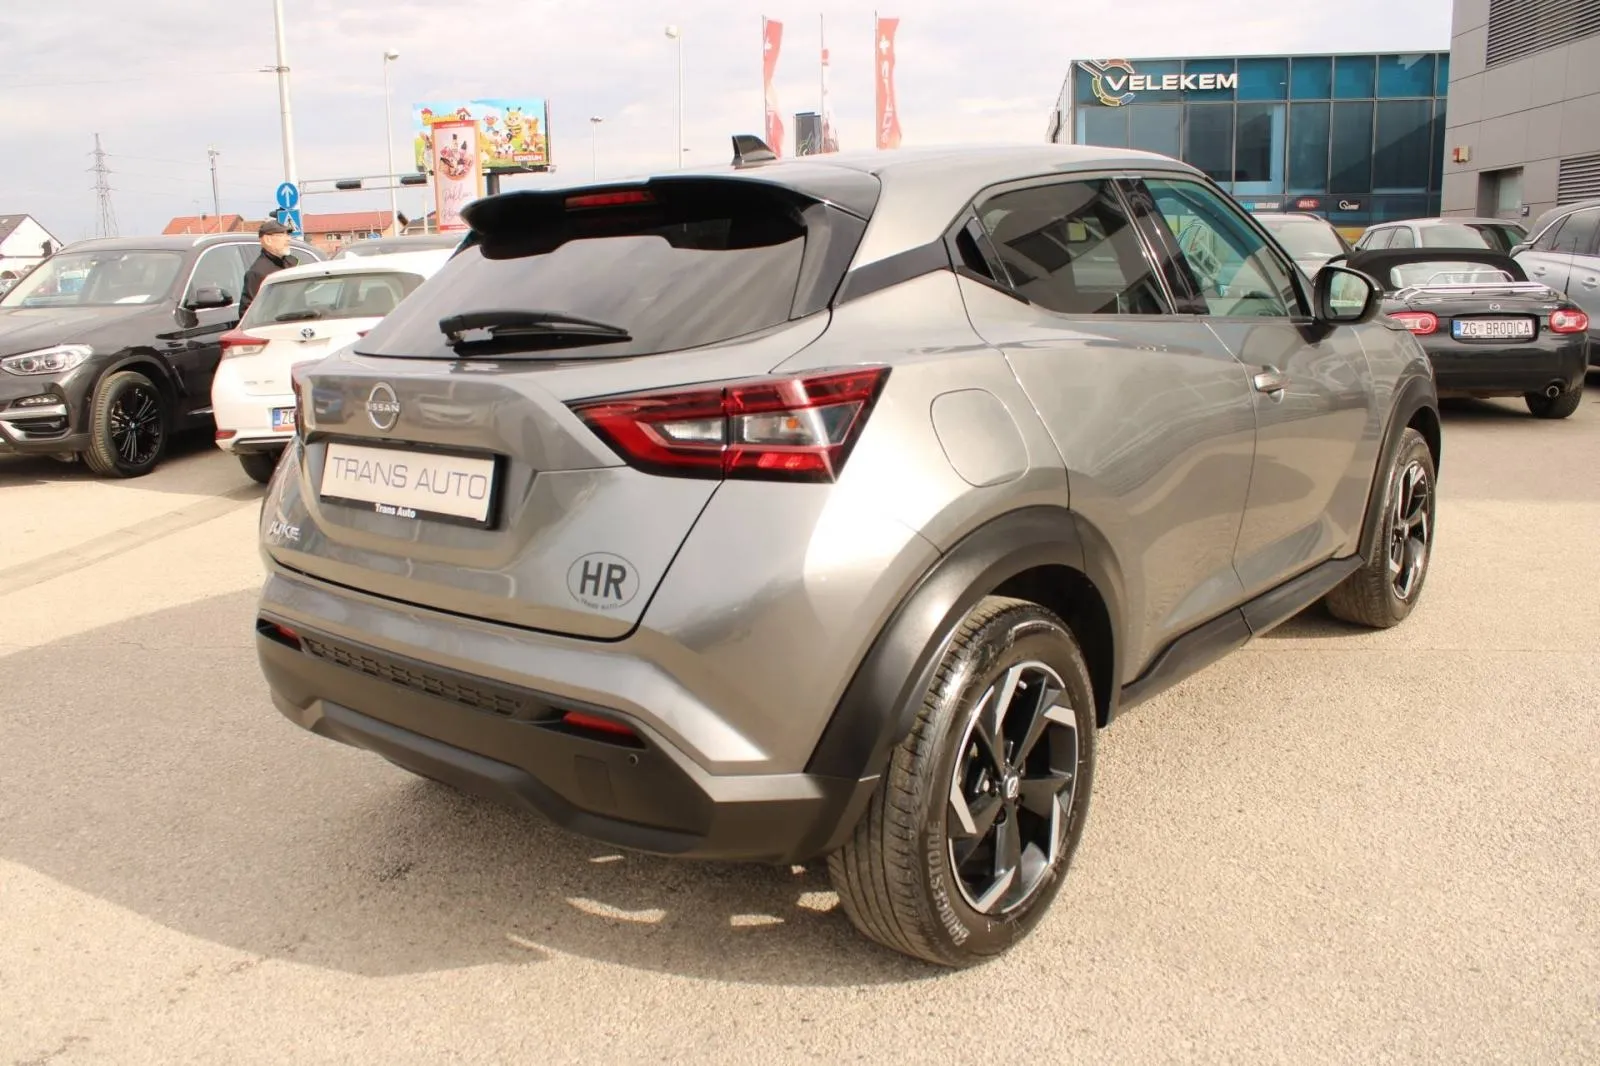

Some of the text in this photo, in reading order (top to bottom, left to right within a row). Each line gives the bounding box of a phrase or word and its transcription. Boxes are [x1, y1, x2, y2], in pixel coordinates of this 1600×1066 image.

[1105, 73, 1238, 91] VELEKEM
[1462, 322, 1531, 335] ZG BRODICA
[366, 401, 400, 412] NISSAN
[332, 456, 488, 500] TRANS AUTO
[375, 503, 416, 519] Trans Auto
[269, 520, 301, 541] JUKE
[580, 560, 627, 601] HR
